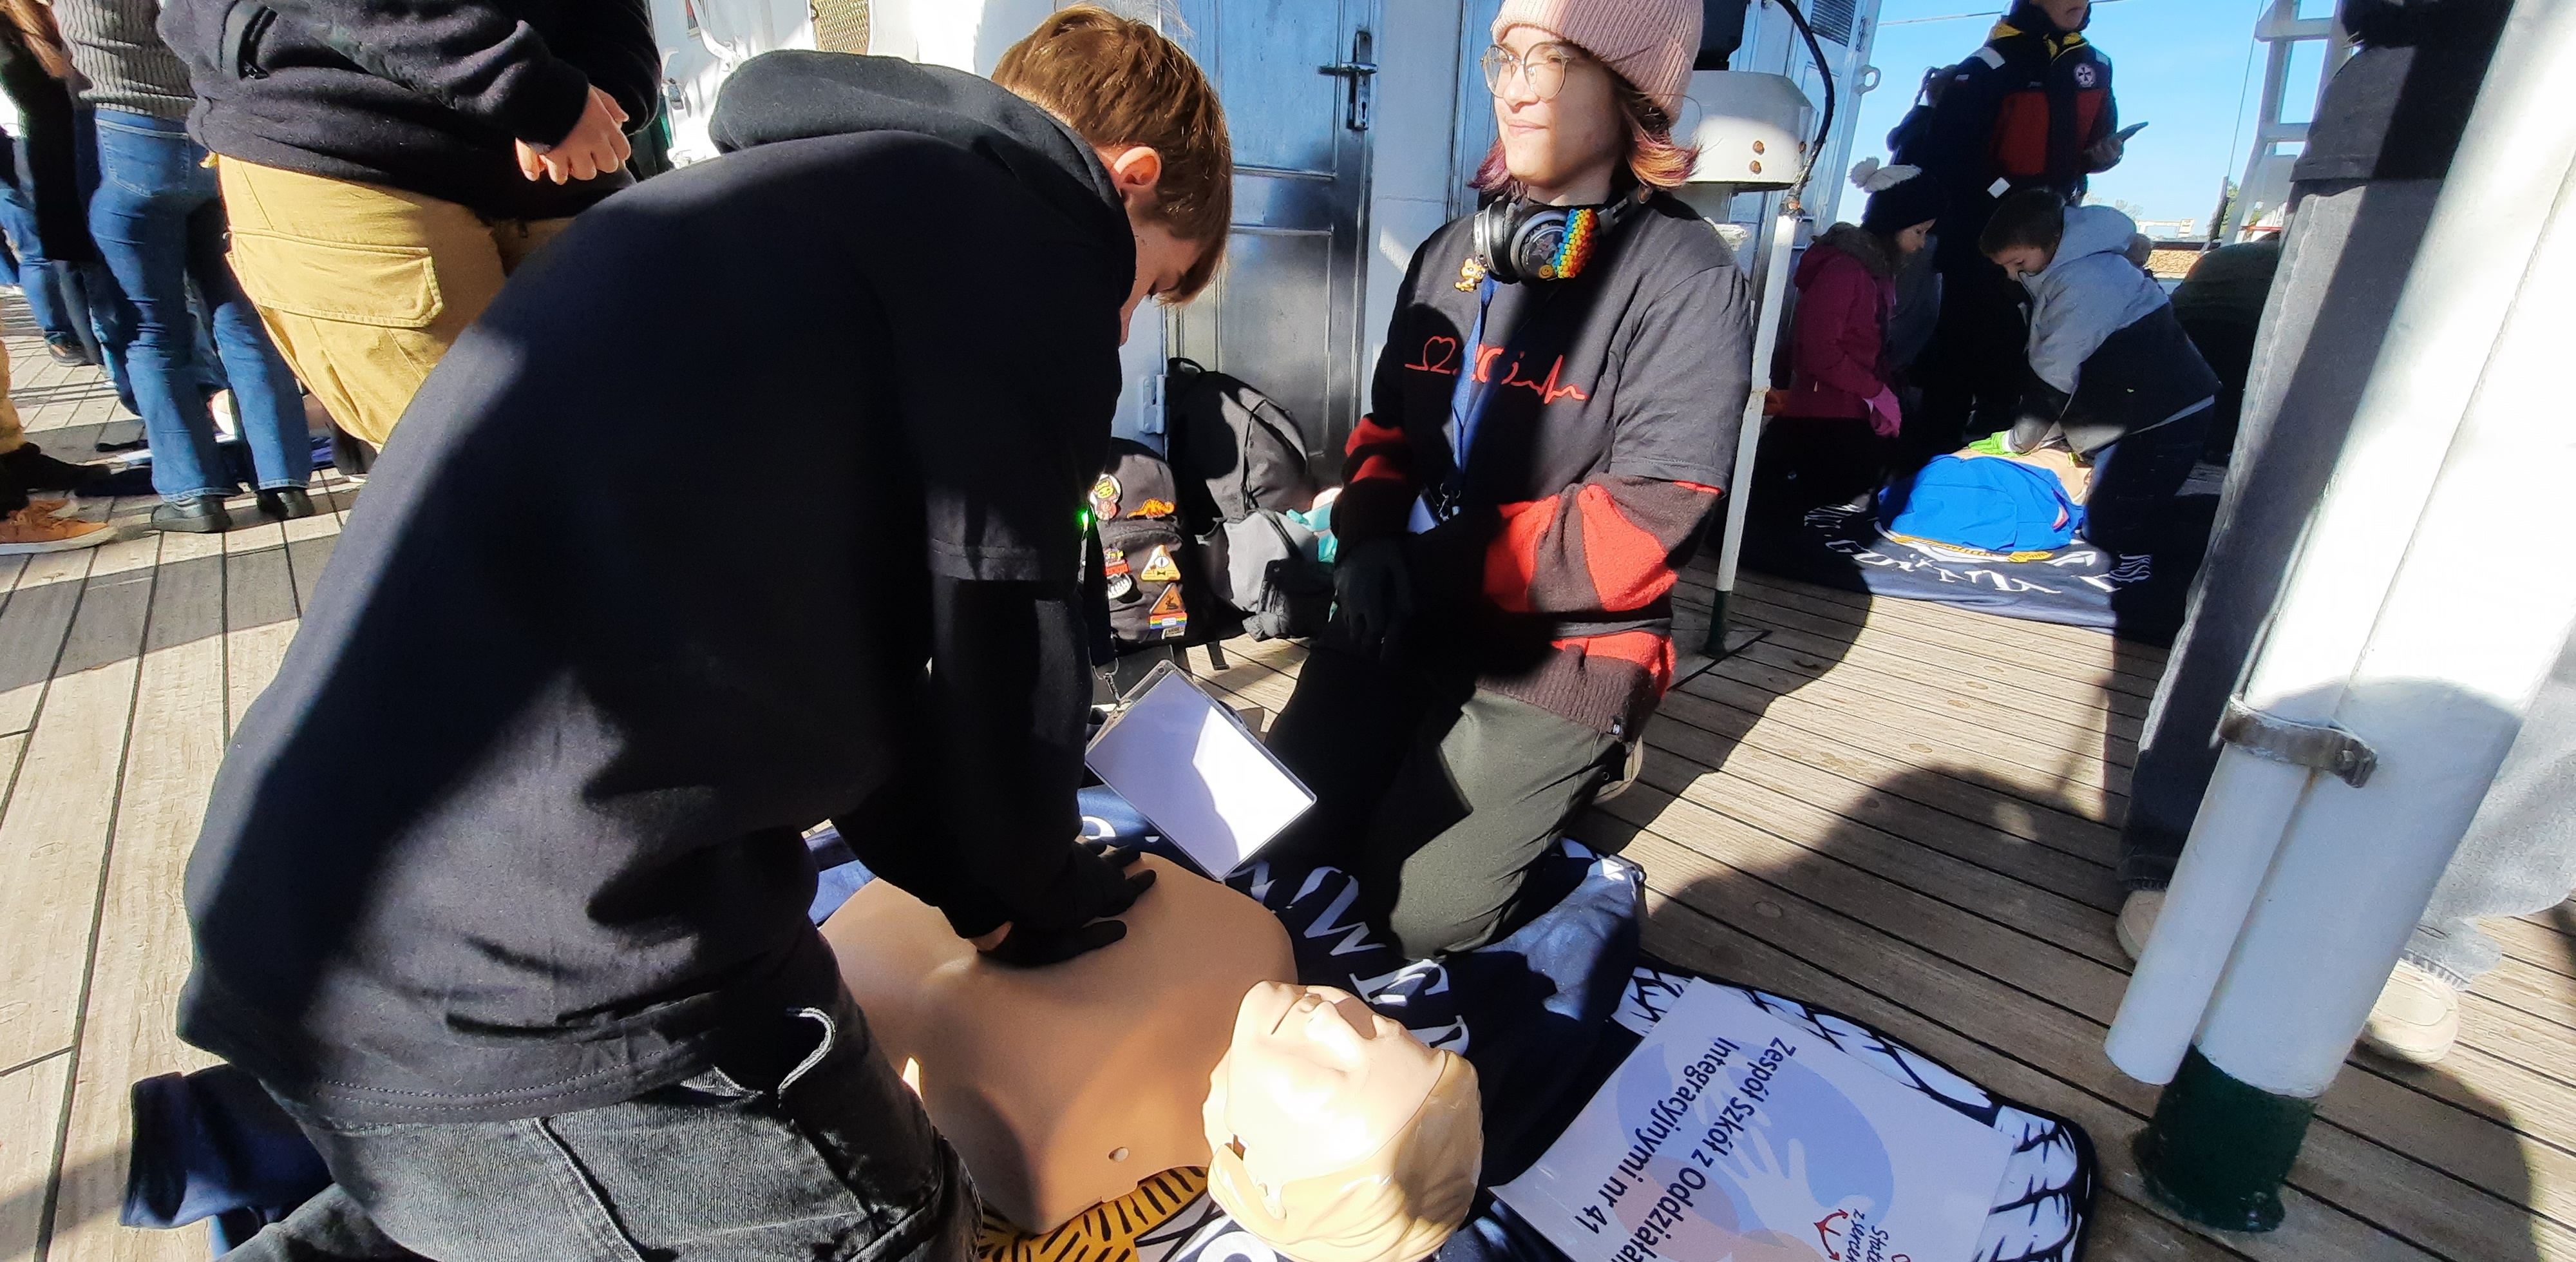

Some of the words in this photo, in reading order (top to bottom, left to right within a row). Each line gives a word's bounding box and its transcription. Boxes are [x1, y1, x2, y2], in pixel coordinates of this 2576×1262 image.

[1738, 1037, 1797, 1103] Zespół
[1617, 1037, 1741, 1183] Integracyjnymi
[1701, 1096, 1756, 1156] Szkół
[1690, 1148, 1714, 1168] z
[1598, 1176, 1629, 1208] nr
[1574, 1205, 1608, 1234] 41
[1853, 1208, 1866, 1220] z
